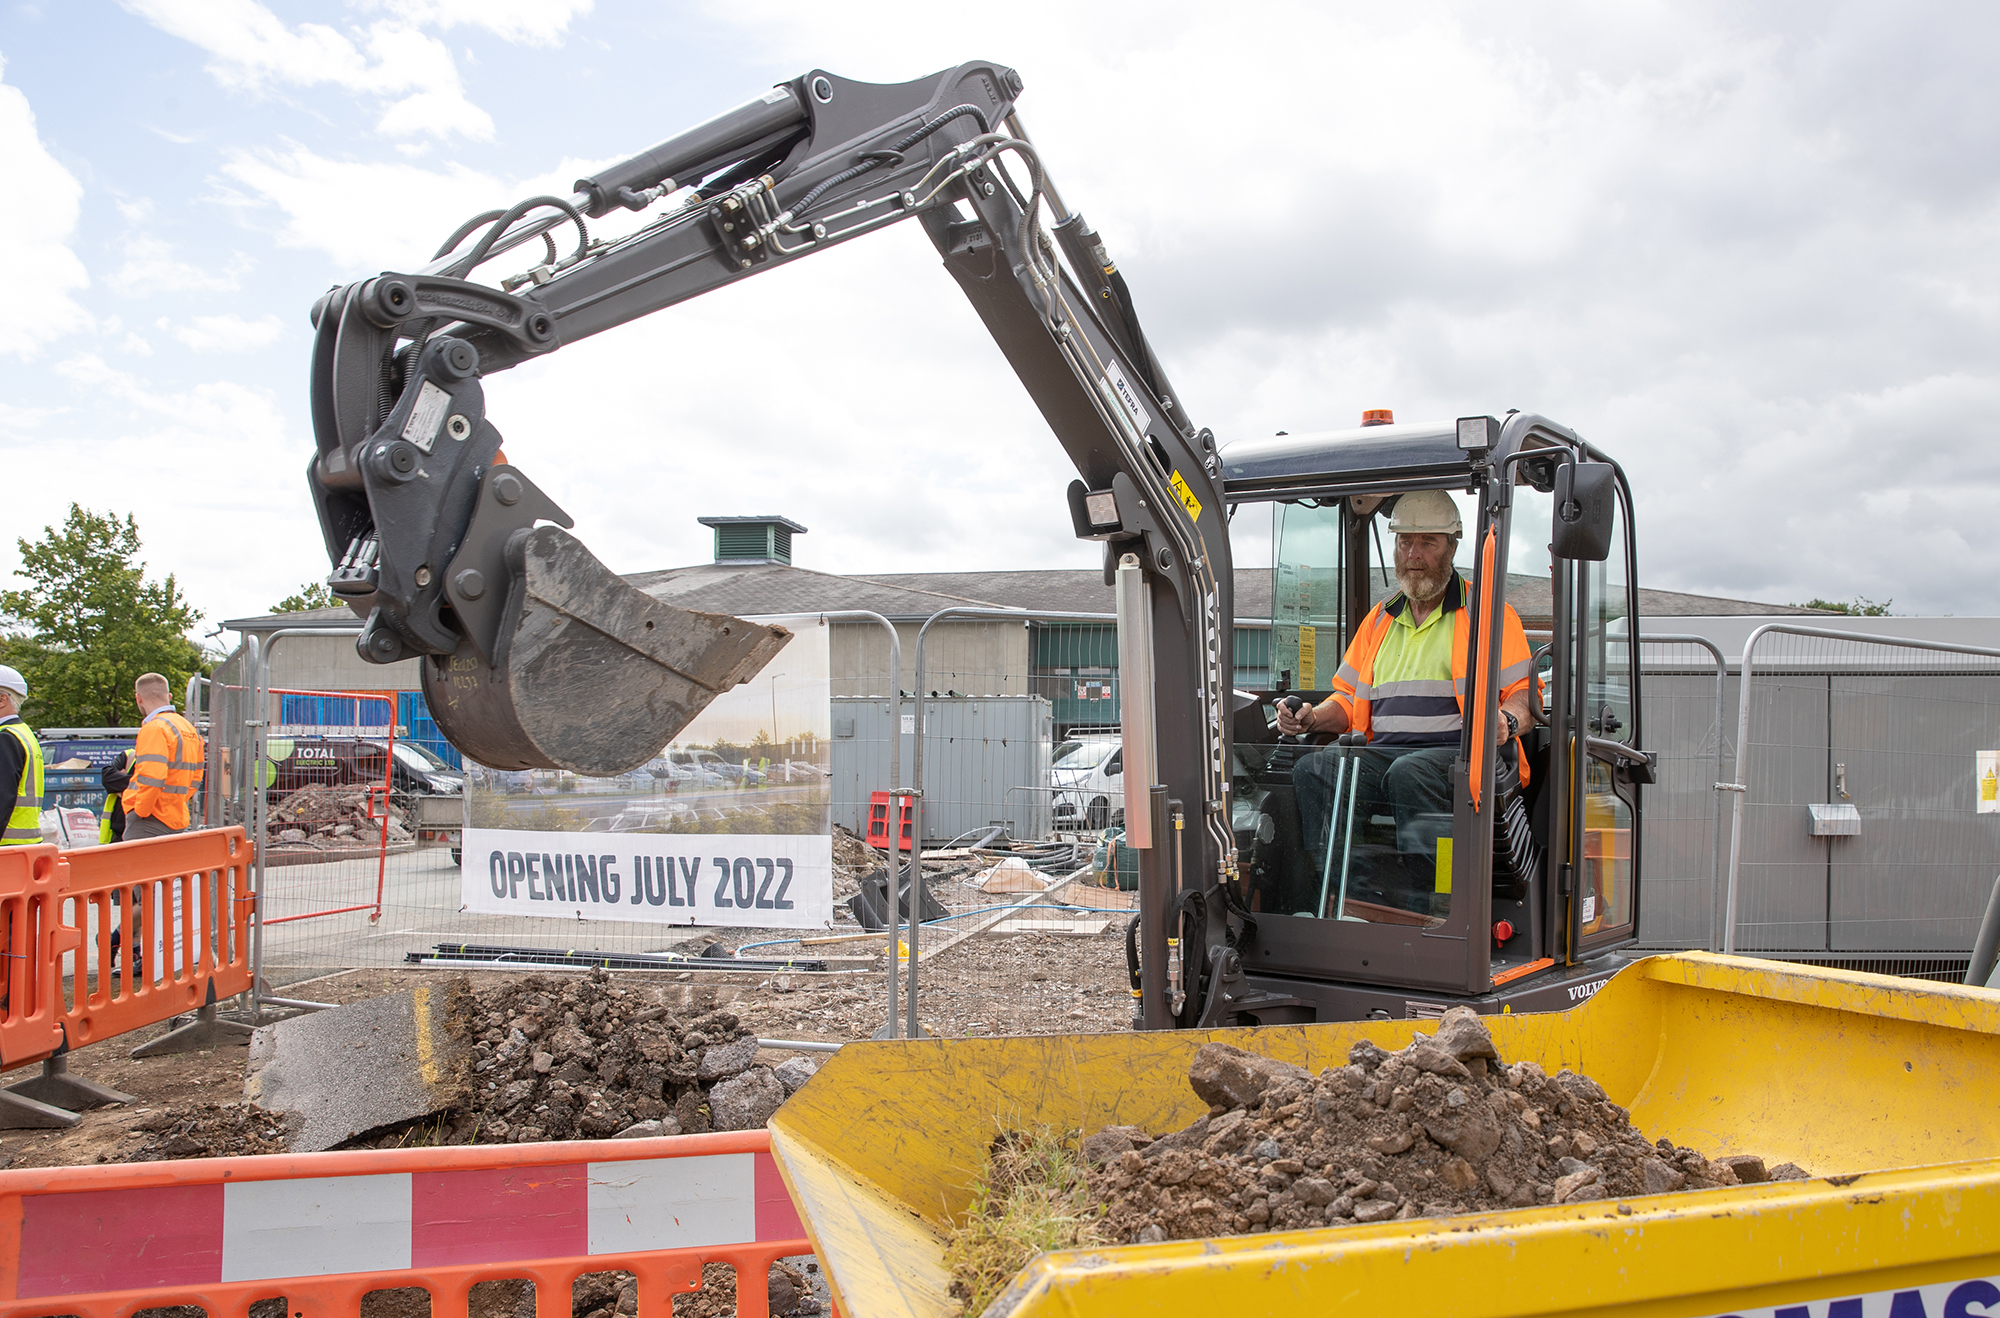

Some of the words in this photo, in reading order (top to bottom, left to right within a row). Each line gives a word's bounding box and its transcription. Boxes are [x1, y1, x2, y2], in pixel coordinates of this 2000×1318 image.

[1121, 388, 1139, 416] TEFRA
[297, 748, 336, 759] TOTAL
[489, 850, 621, 904] OPENING
[630, 855, 701, 907] JULY
[713, 857, 794, 909] 2022
